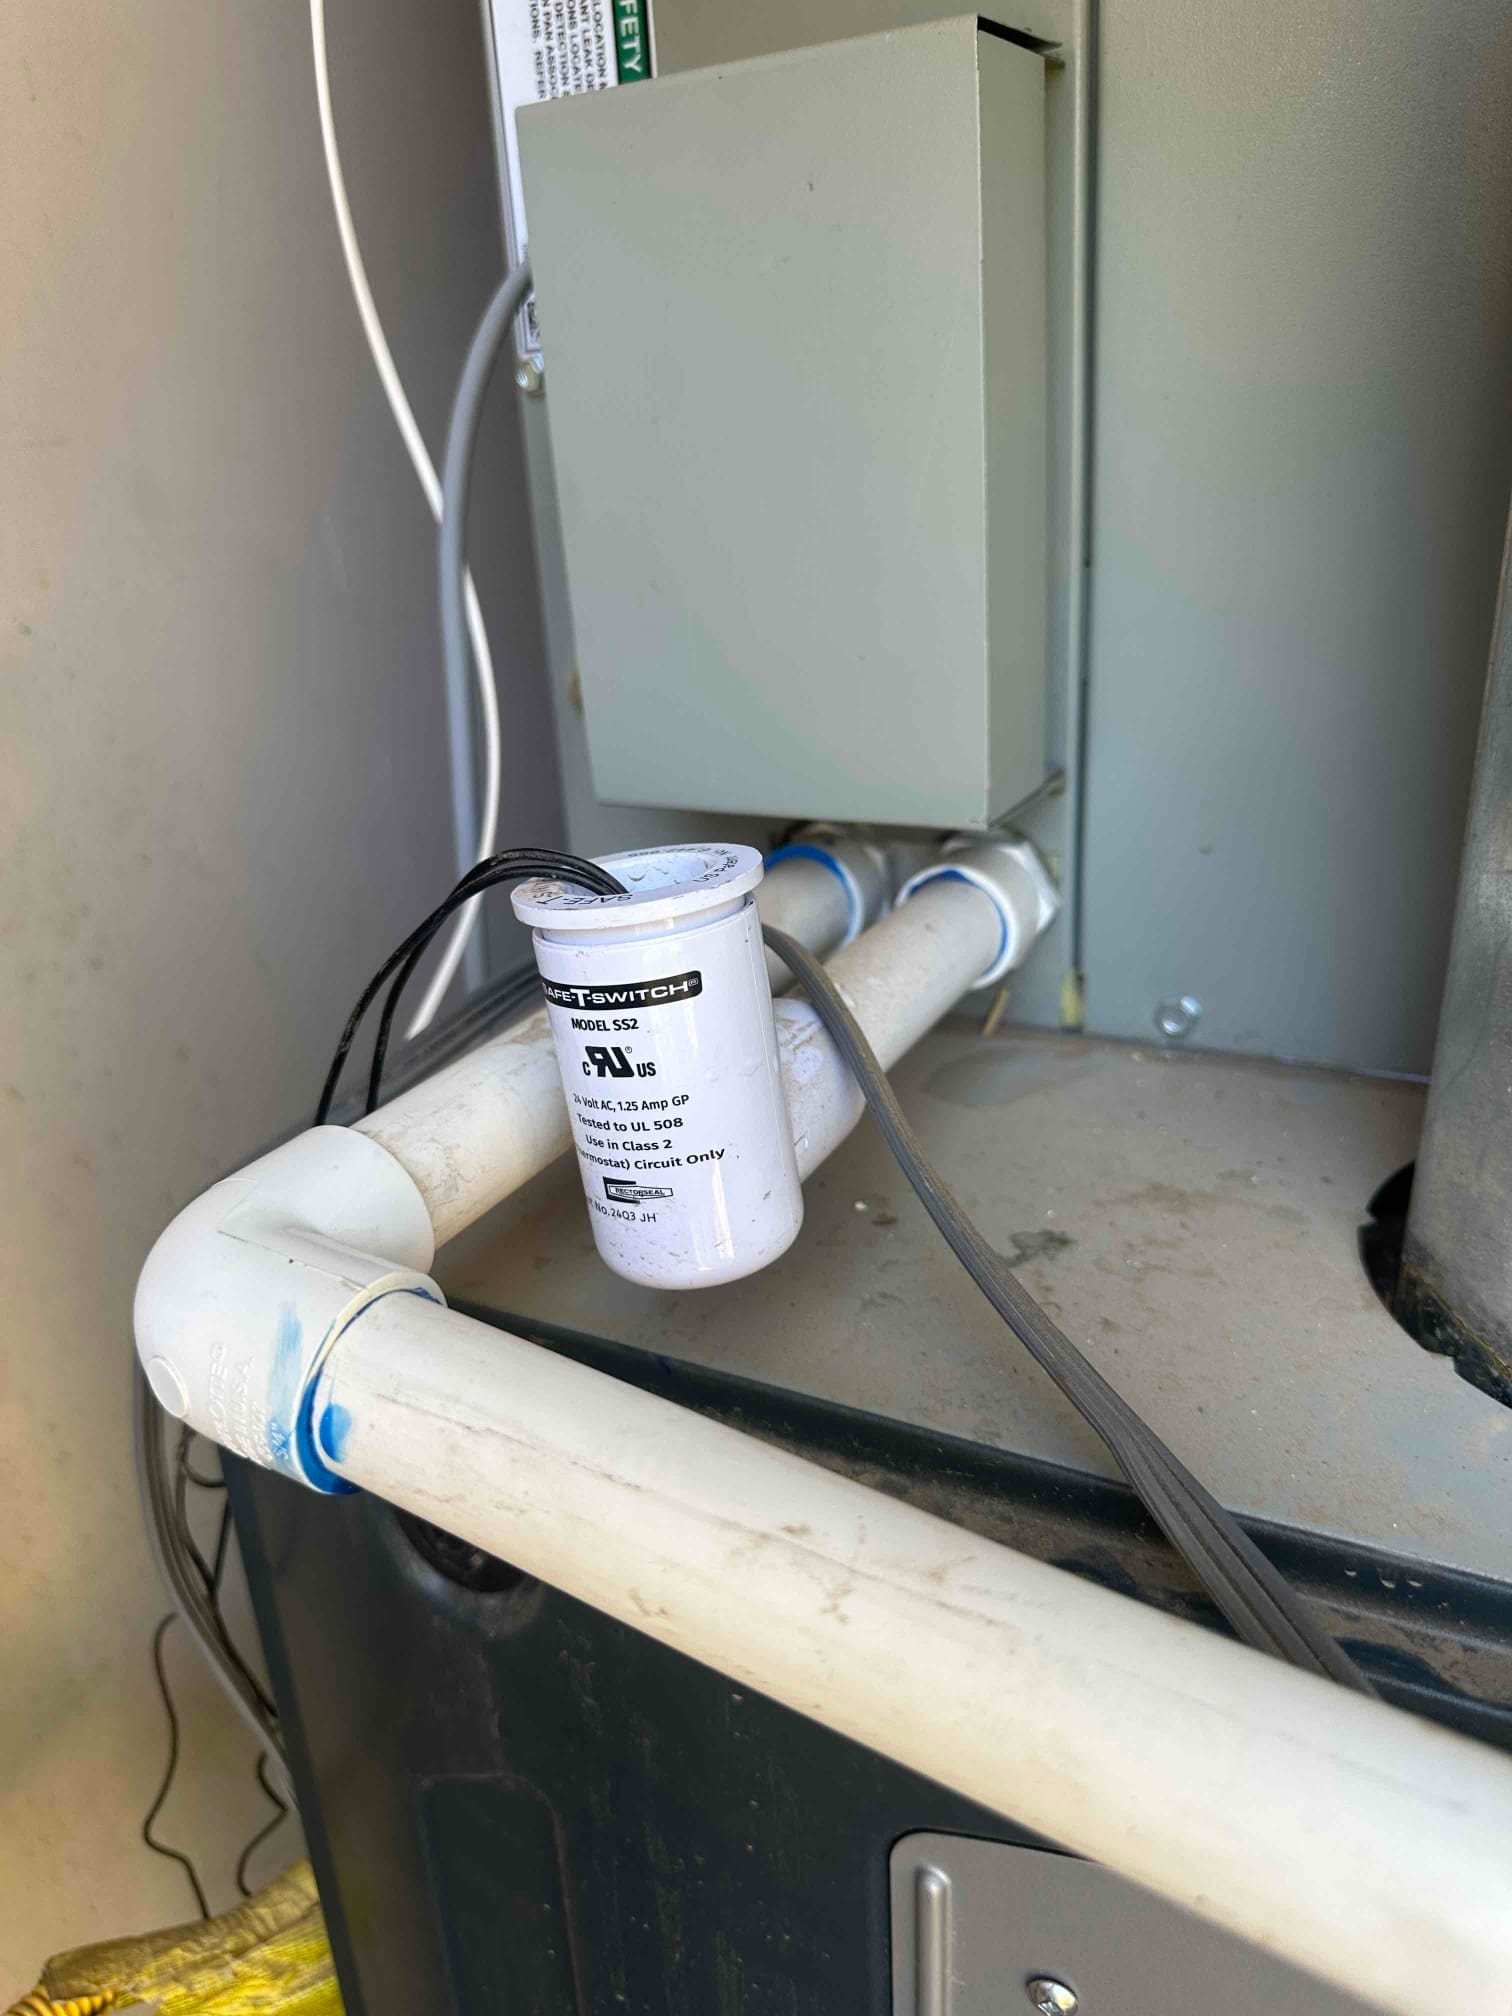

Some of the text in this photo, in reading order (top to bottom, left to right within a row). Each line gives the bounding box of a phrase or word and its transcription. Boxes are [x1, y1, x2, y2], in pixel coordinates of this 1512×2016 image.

[592, 0, 609, 78] LOCATION
[581, 28, 595, 71] LEAK
[571, 1017, 639, 1031] MODEL SS2
[636, 1061, 657, 1077] US
[582, 1095, 600, 1110] Volt
[600, 1100, 617, 1113] AC,
[617, 1101, 639, 1111] 1.25
[641, 1099, 669, 1111] Amp
[672, 1094, 690, 1107] GP
[577, 1112, 684, 1132] Tested to UL 508
[585, 1133, 673, 1152] Use in Class 2
[634, 1157, 683, 1170] Circuit
[686, 1148, 726, 1165] Only
[640, 1212, 657, 1223] JH
